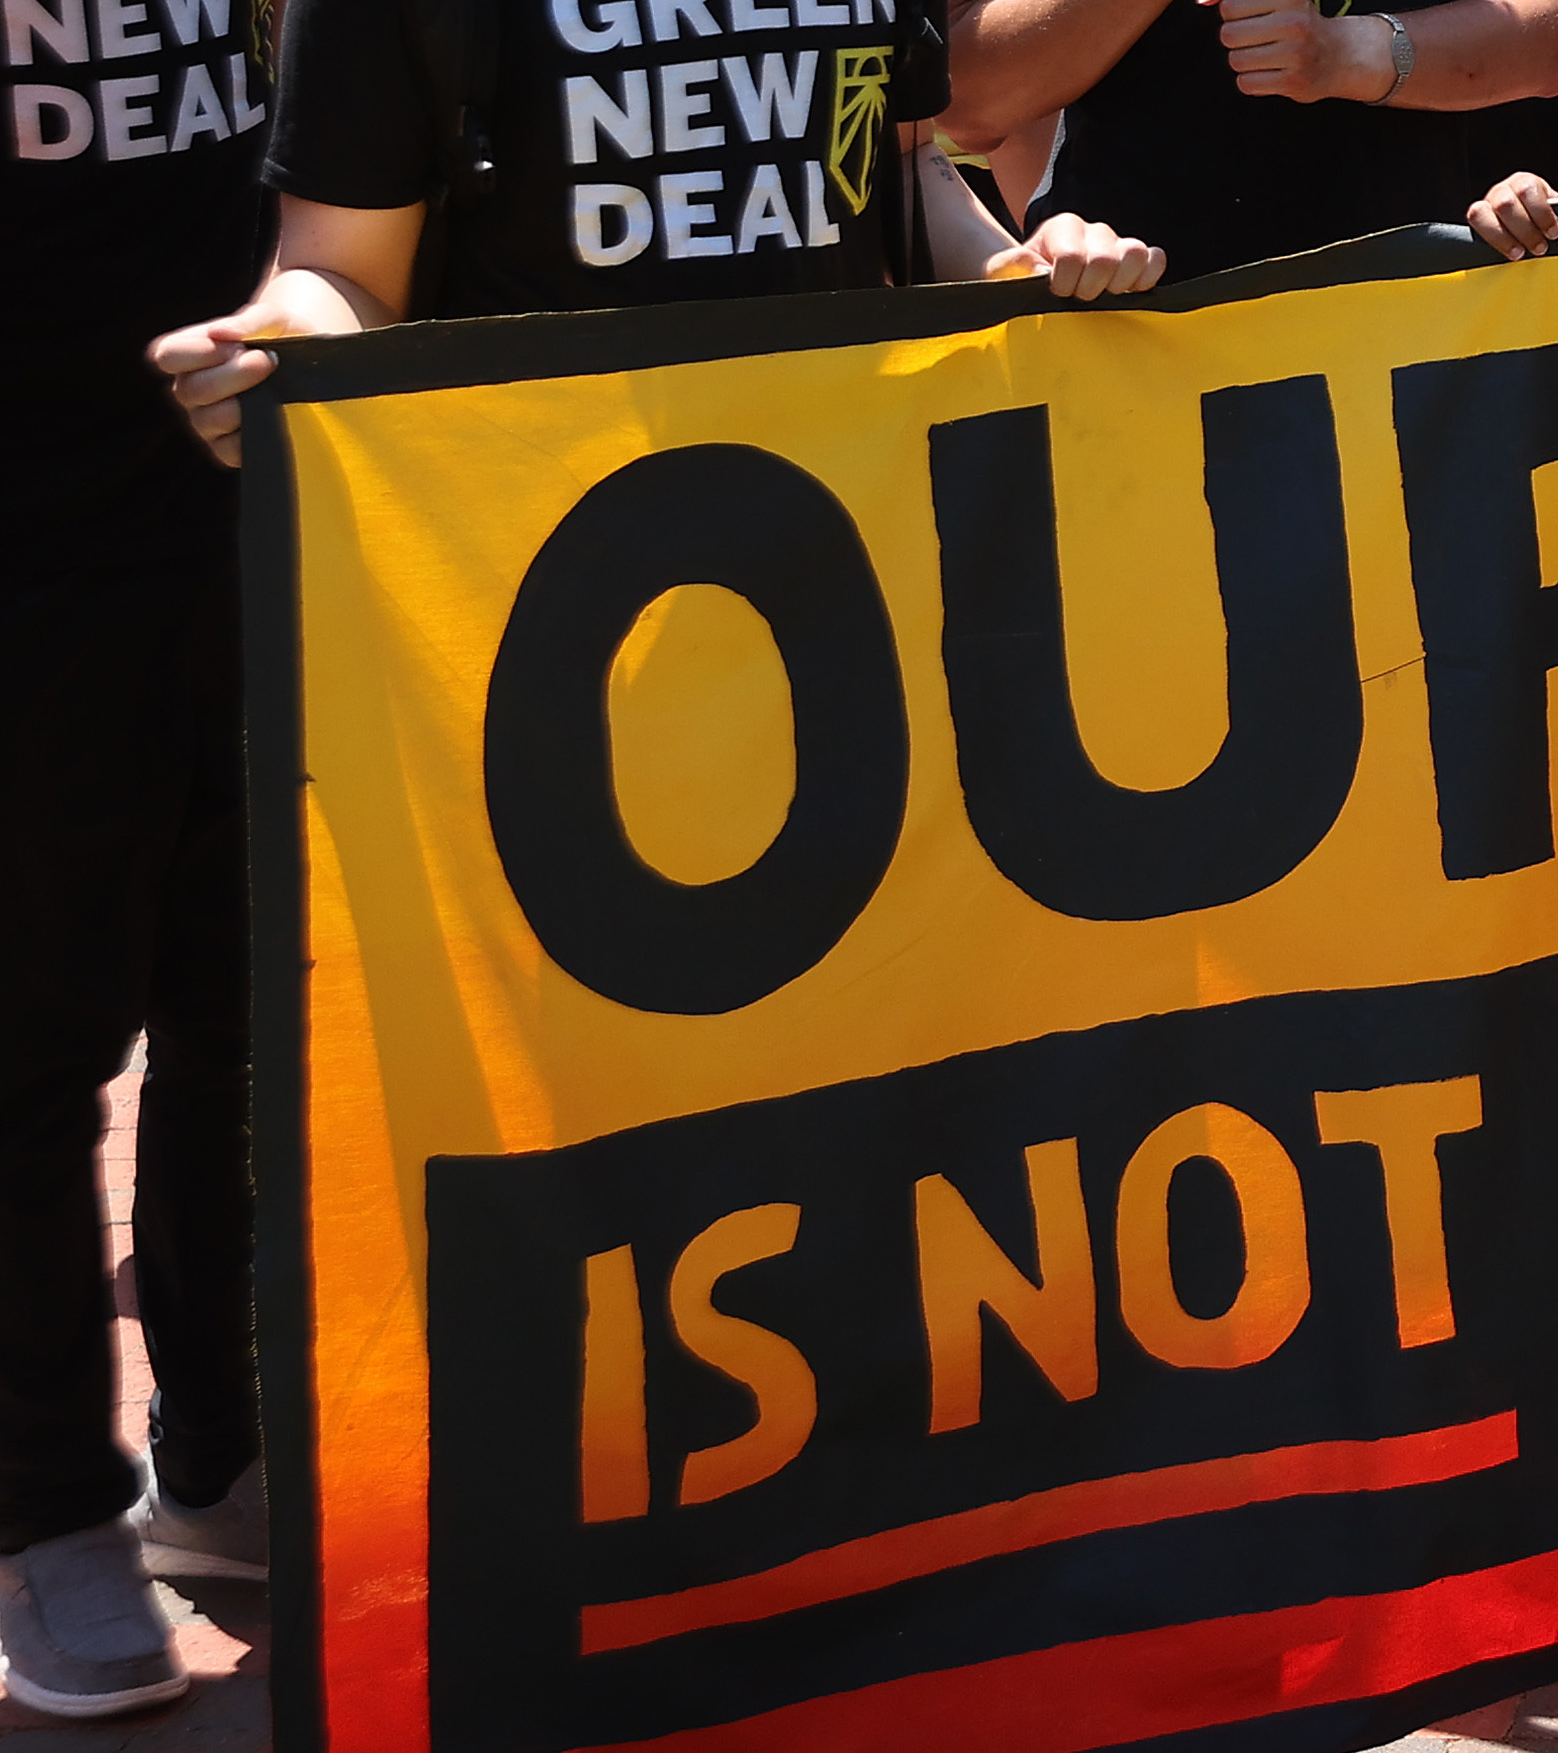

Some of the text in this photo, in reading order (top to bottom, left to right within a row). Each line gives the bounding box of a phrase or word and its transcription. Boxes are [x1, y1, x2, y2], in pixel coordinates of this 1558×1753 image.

[9, 57, 267, 163] DEAL
[563, 48, 822, 166] NEW
[572, 158, 841, 267] DEAL
[581, 1200, 819, 1525] IS
[914, 1075, 1486, 1436] NOT
